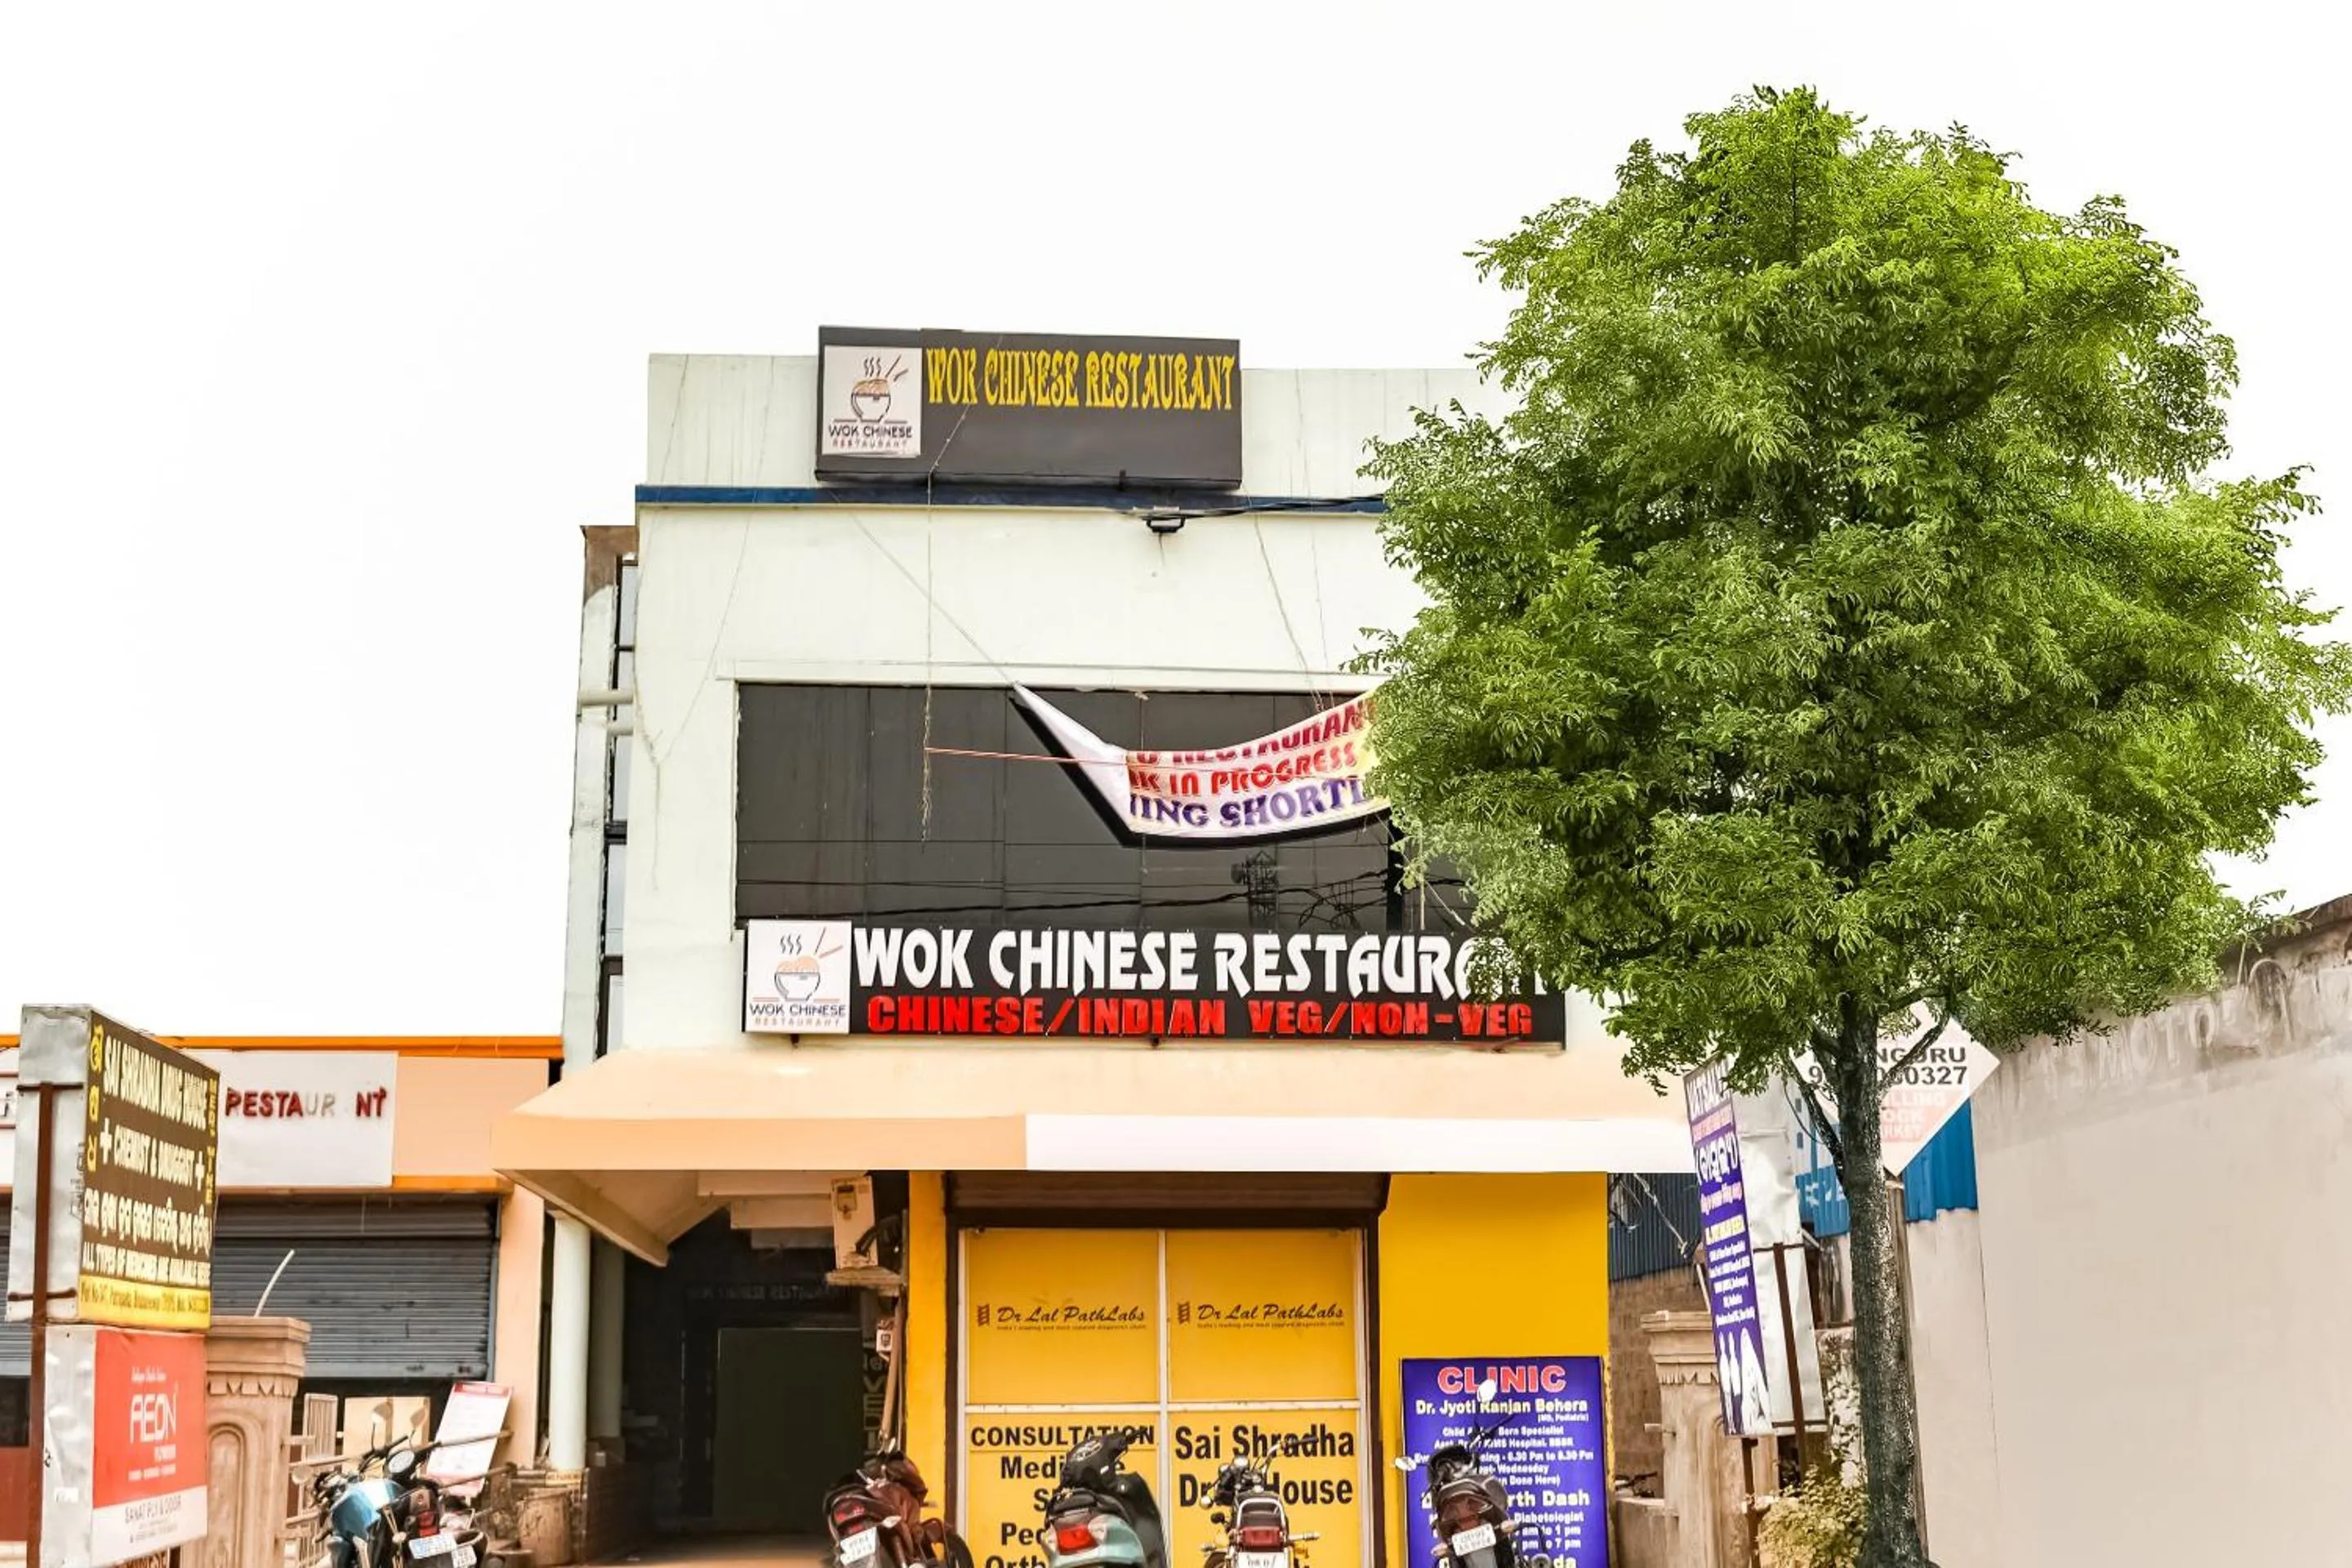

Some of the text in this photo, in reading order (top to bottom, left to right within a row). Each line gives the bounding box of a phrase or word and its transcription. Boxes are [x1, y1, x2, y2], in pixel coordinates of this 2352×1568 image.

[926, 347, 1236, 411] WOK CHINESE RESTAURANT
[829, 425, 912, 439] WOK CHINESE
[1169, 771, 1200, 796] IN
[1211, 741, 1357, 795] PROGRESS
[1219, 776, 1366, 828] SHORTL
[853, 928, 974, 989] WOK
[989, 929, 1198, 996] CHINESE
[749, 1004, 847, 1017] WOK CHINESE
[867, 995, 1226, 1035] CHINESE/INDIAN
[225, 1086, 387, 1118] RESTAURNT
[996, 1305, 1145, 1324] Dr Lal PathLabs
[1197, 1303, 1343, 1321] Dr Lal PathLabs
[1415, 1400, 1436, 1414] Dr.
[1440, 1399, 1476, 1417] Jyoti
[1535, 1397, 1588, 1413] Behera
[971, 1425, 1155, 1447] CONSULTATION
[1175, 1423, 1355, 1460] Sai Shradha
[1545, 1451, 1556, 1461] to
[1265, 1472, 1353, 1506] House
[1543, 1489, 1591, 1507] Dash
